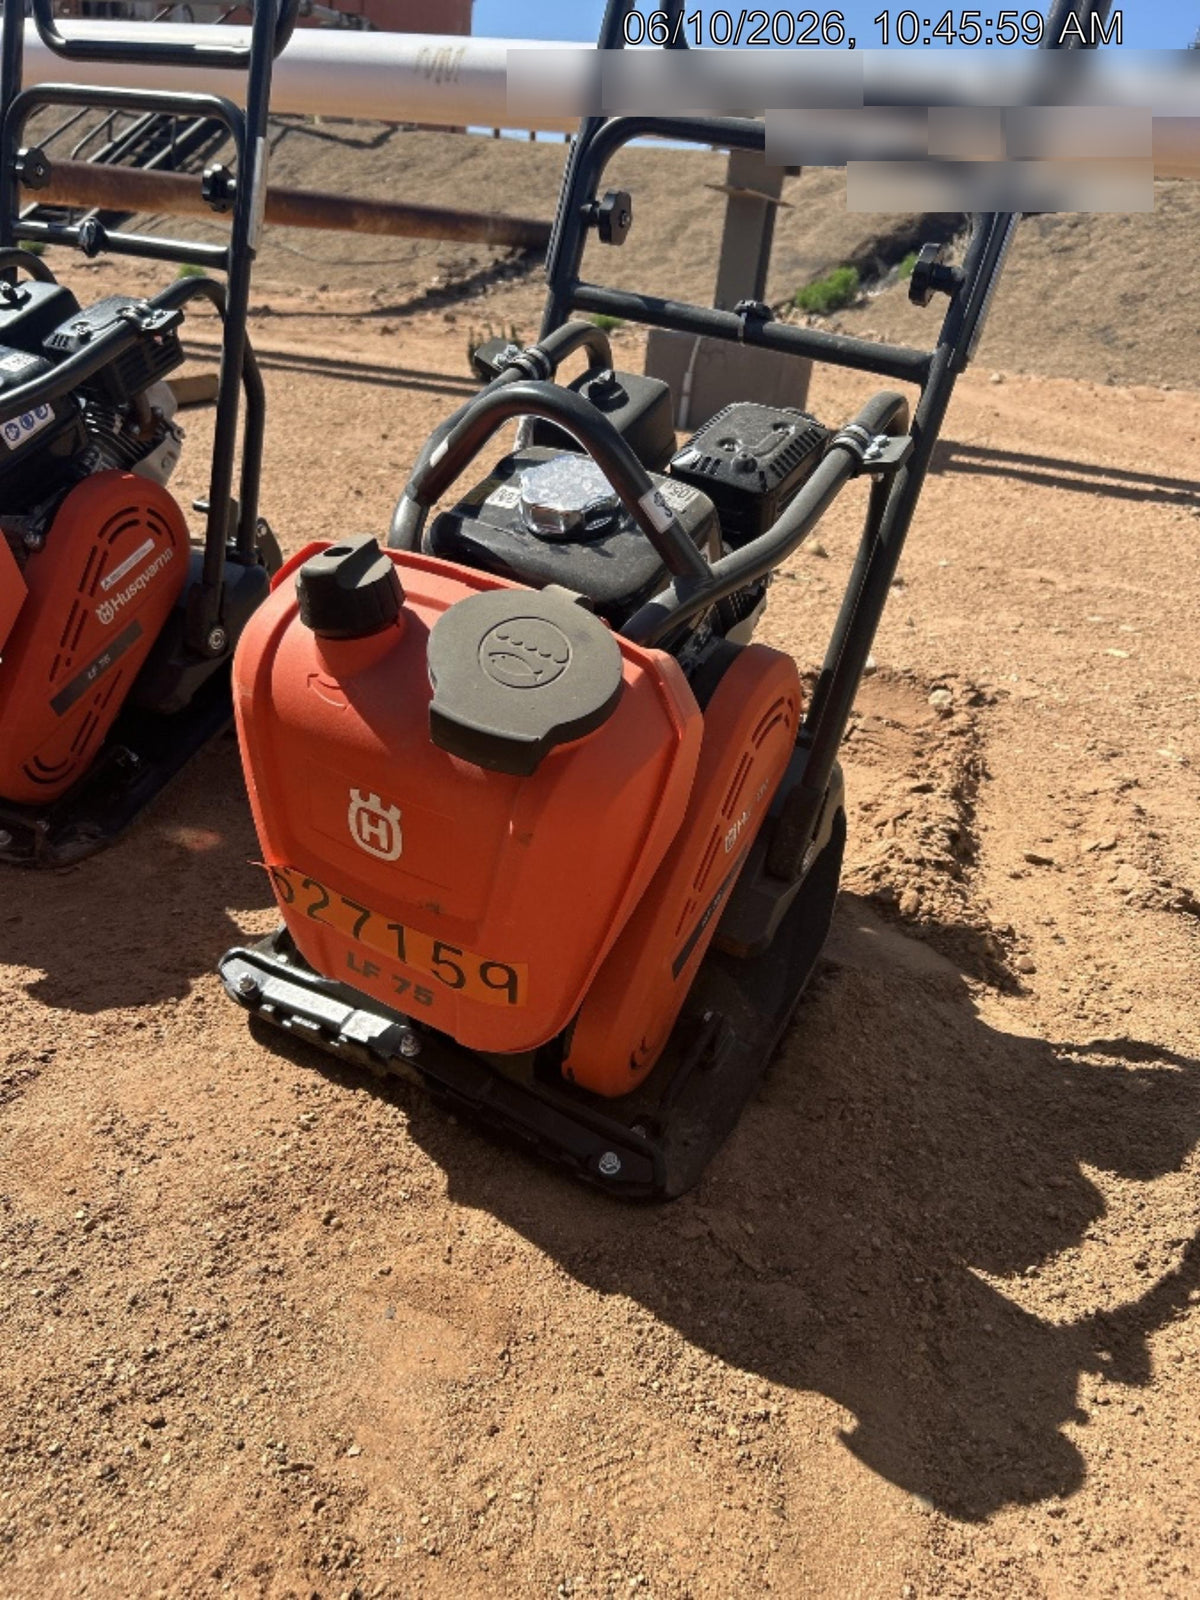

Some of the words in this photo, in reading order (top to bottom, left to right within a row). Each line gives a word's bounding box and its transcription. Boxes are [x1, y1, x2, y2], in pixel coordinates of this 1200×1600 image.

[110, 548, 173, 611] Husqvarna
[346, 950, 381, 978] LF
[391, 976, 434, 1007] 75
